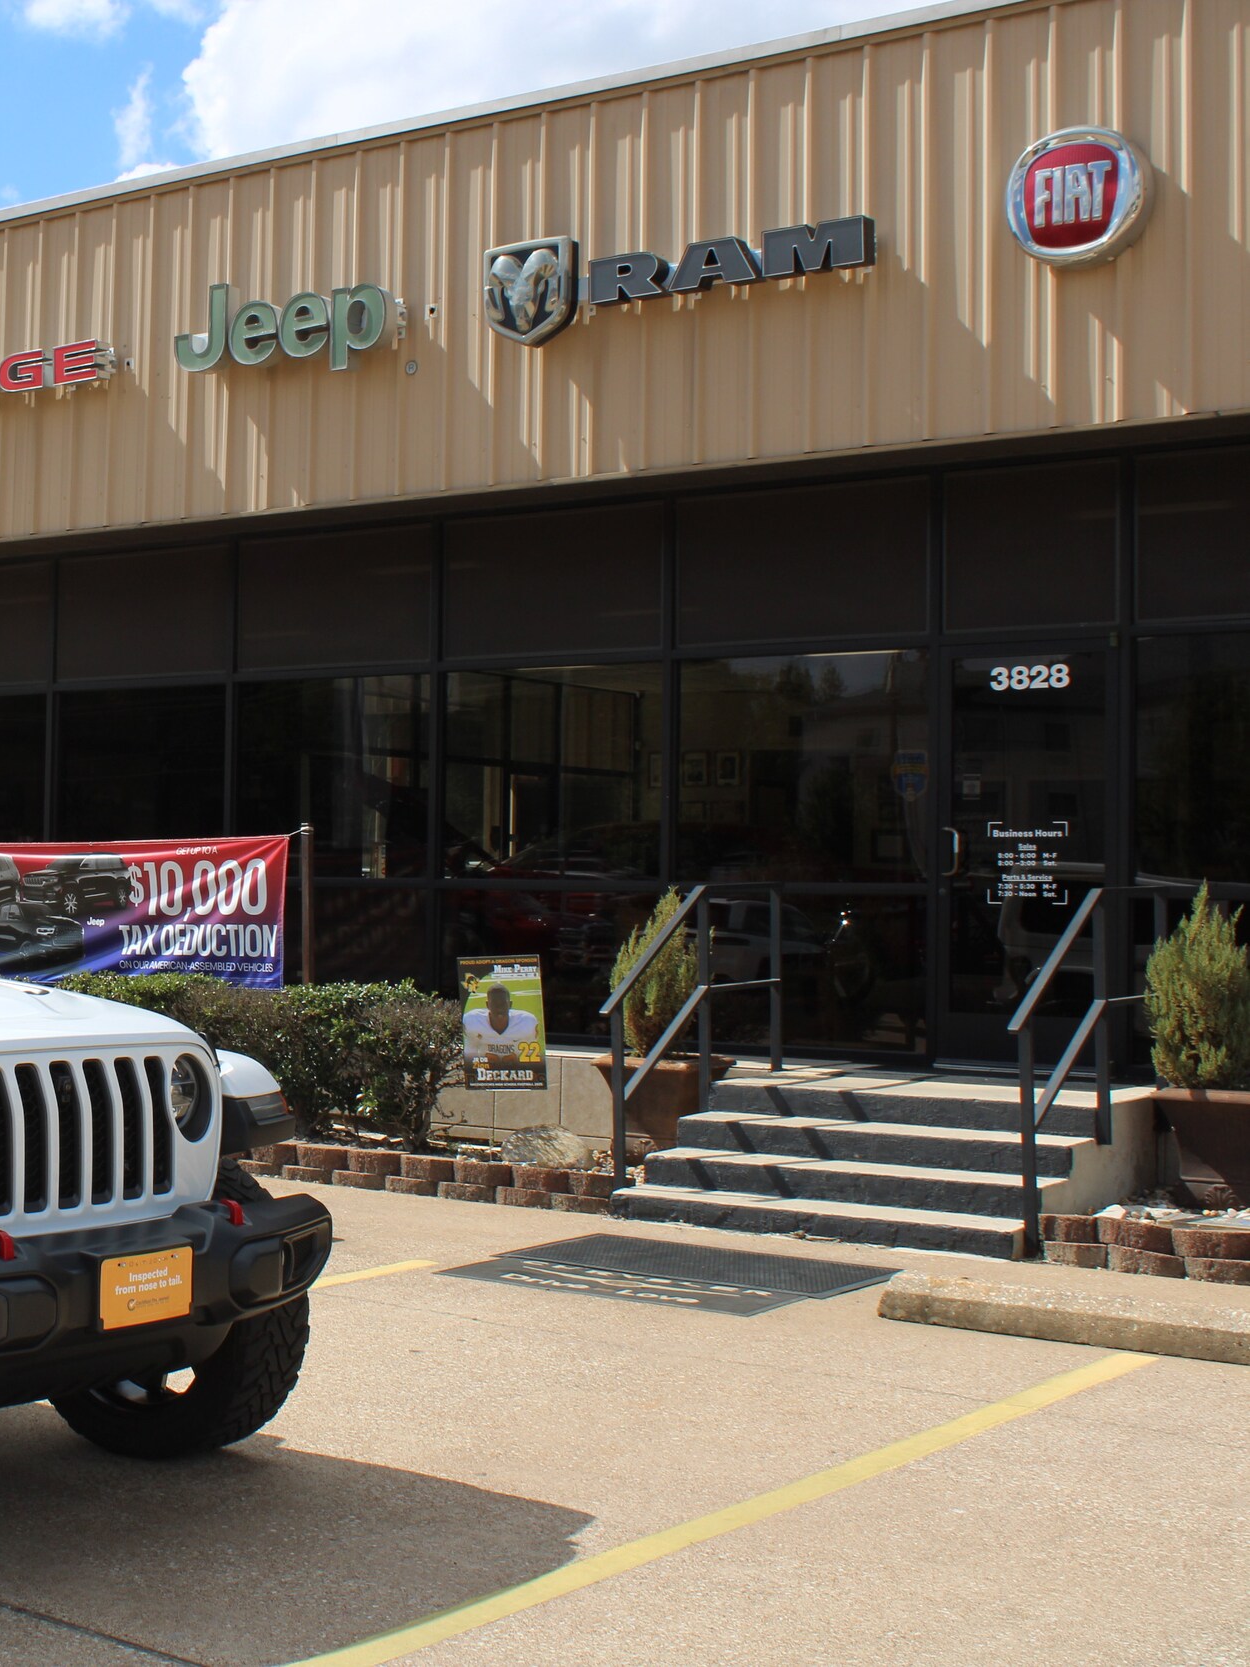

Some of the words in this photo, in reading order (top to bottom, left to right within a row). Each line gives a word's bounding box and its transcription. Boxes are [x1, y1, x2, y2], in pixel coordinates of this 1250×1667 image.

[1033, 159, 1113, 228] FIAT
[588, 214, 874, 305] RAM
[173, 282, 392, 373] Jeep
[990, 663, 1070, 691] 3828
[992, 829, 1034, 838] Business
[1034, 829, 1063, 838] Hours
[190, 846, 201, 855] UP
[201, 846, 211, 855] TO
[212, 846, 218, 854] A
[127, 858, 268, 922] $10,000
[86, 916, 105, 927] Jeep
[118, 924, 159, 956] TAX
[159, 924, 278, 958] DEDUCTION
[119, 960, 132, 969] ON
[132, 960, 150, 969] OUR
[149, 961, 236, 971] AMERICAN-ASSEMBLED
[236, 962, 274, 973] VEHICLES
[487, 1044, 515, 1053] DRAGONS
[518, 1041, 541, 1063] 22
[115, 1285, 136, 1295] from
[138, 1282, 158, 1292] nose
[159, 1279, 167, 1288] to
[168, 1274, 183, 1286] tail.
[129, 1266, 168, 1282] Inspected
[500, 1272, 590, 1290] Drive
[615, 1289, 700, 1304] Love
